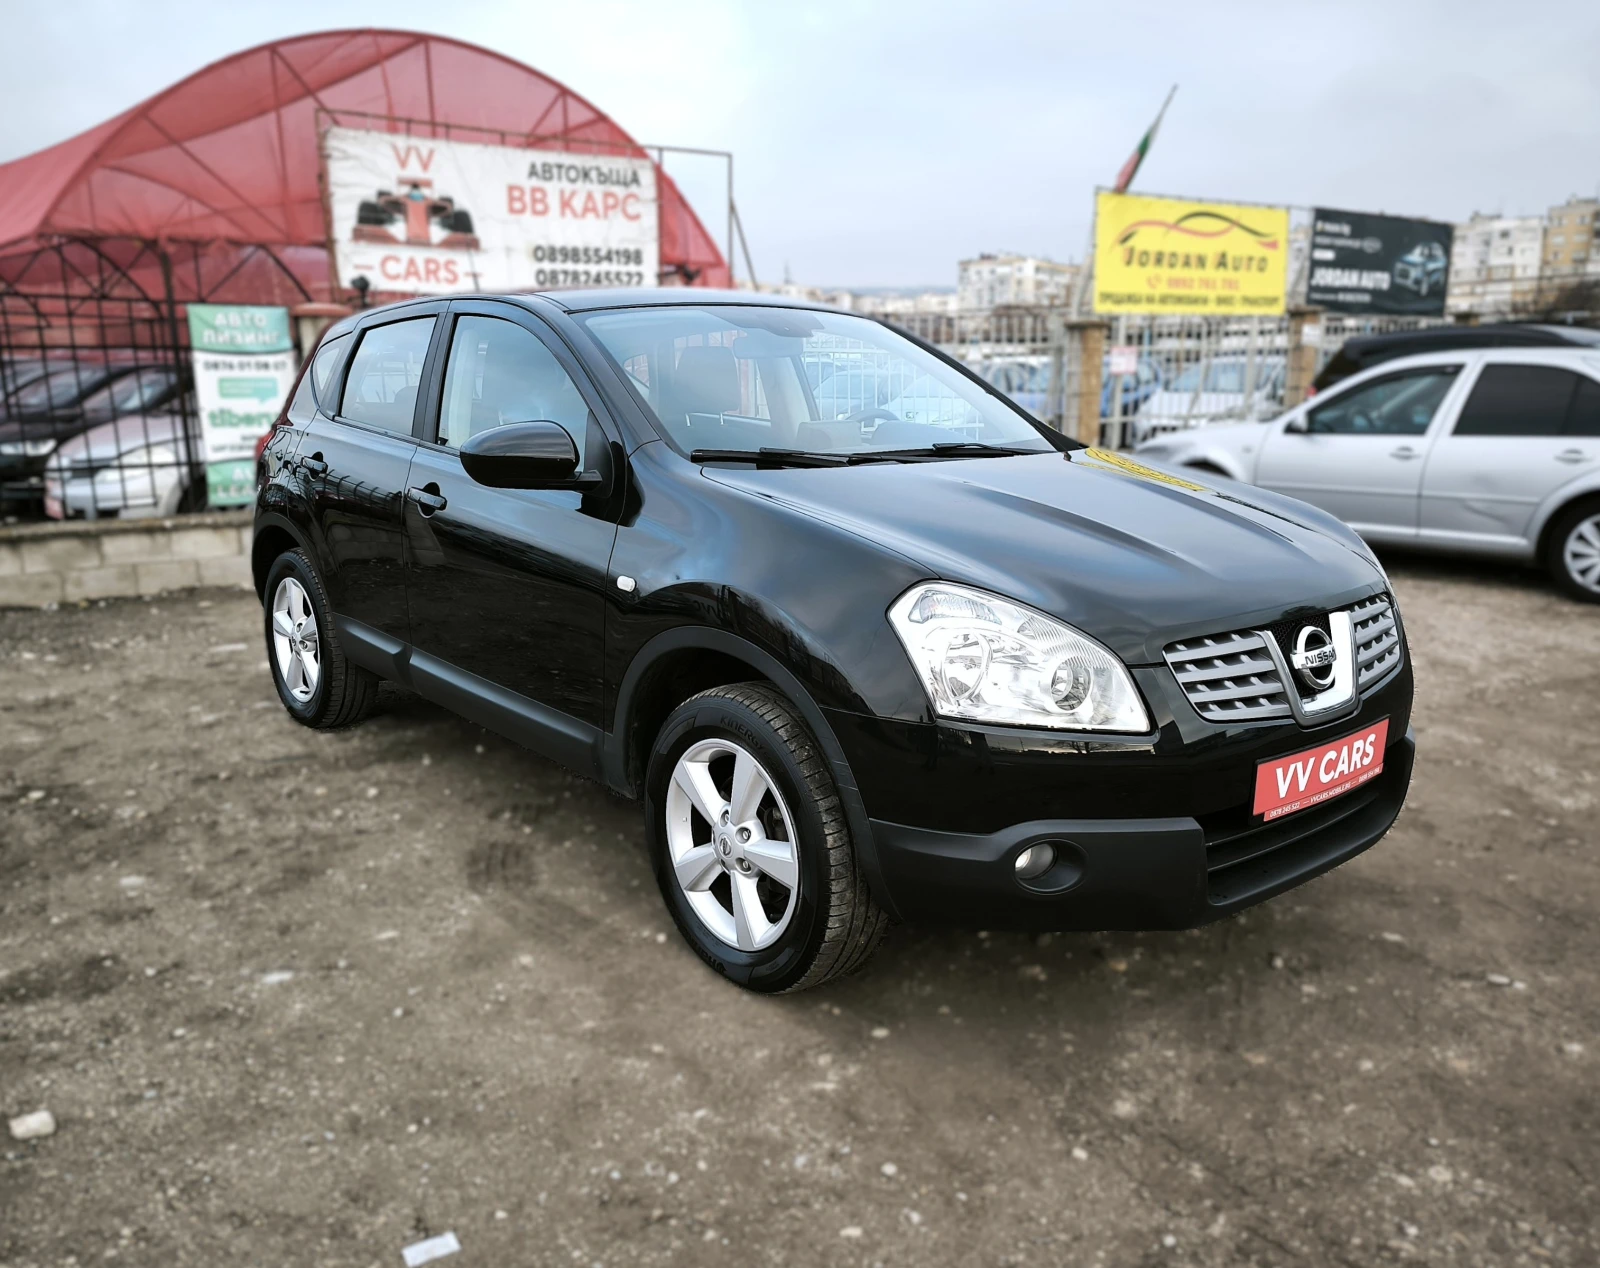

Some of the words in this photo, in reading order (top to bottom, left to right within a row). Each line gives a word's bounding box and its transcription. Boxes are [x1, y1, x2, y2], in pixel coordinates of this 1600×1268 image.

[392, 144, 435, 172] VV
[527, 162, 641, 187] АВТОКЪЩА
[559, 189, 642, 222] КАРС
[533, 244, 643, 265] 0898554198
[1124, 245, 1208, 270] JORDAN
[380, 254, 460, 286] CARS
[1275, 757, 1316, 799] VV
[1318, 733, 1377, 784] CARS
